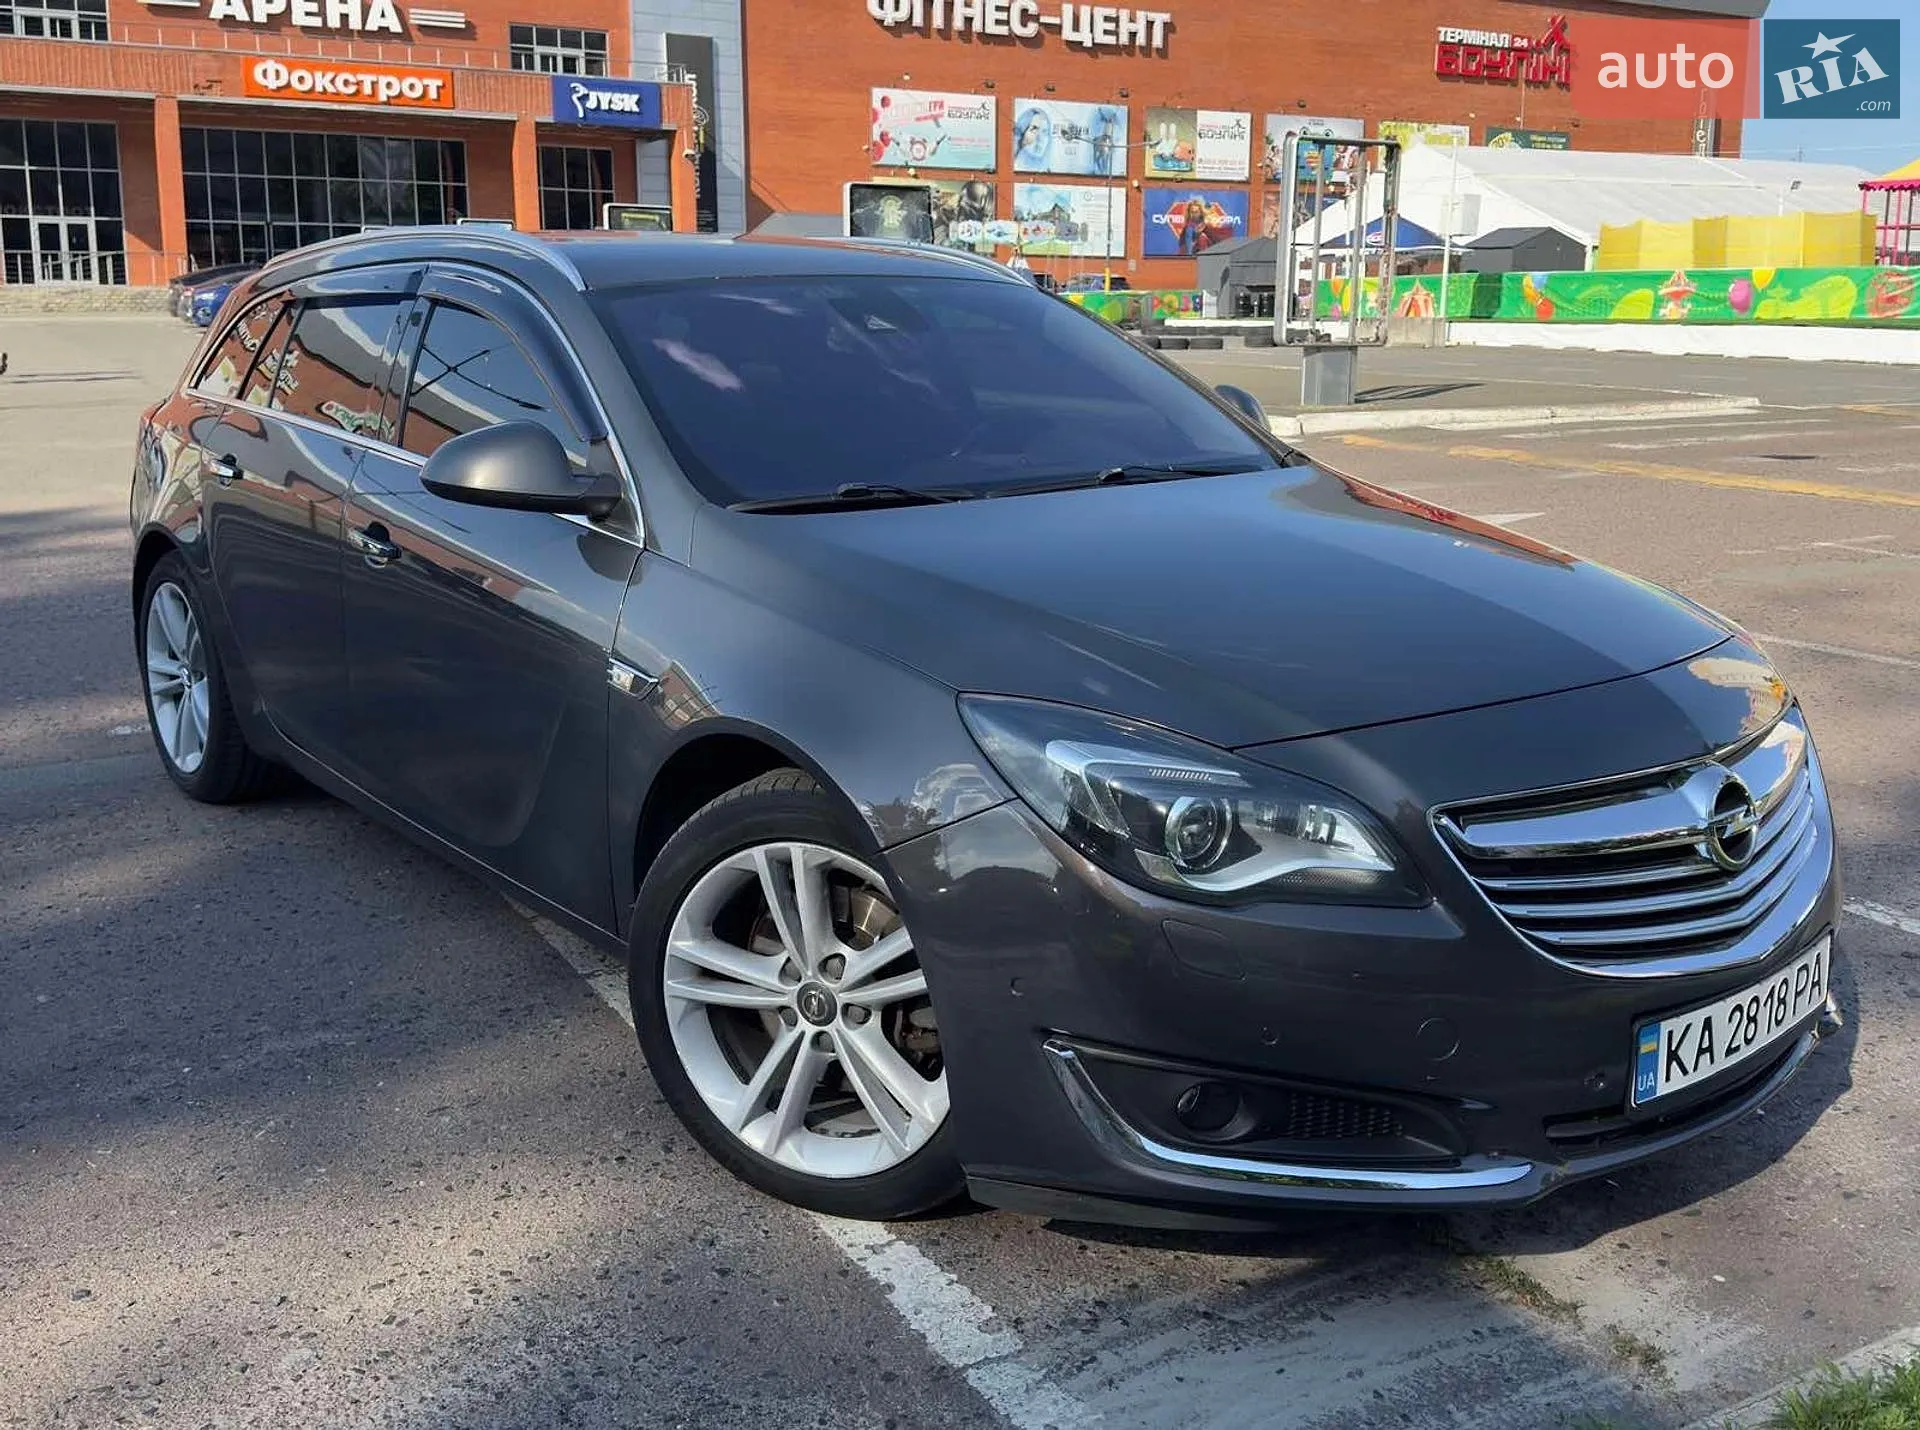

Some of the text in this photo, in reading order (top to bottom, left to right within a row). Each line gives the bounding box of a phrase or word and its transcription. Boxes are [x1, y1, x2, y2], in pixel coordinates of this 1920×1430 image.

[209, 0, 403, 33] АРЕНА
[1437, 26, 1528, 49] ТЕРМІНАЛ 24
[253, 60, 443, 102] Фокстрот
[586, 89, 640, 113] JYSK
[1665, 952, 1822, 1083] KA 2818 PA
[1637, 1072, 1655, 1092] UA
